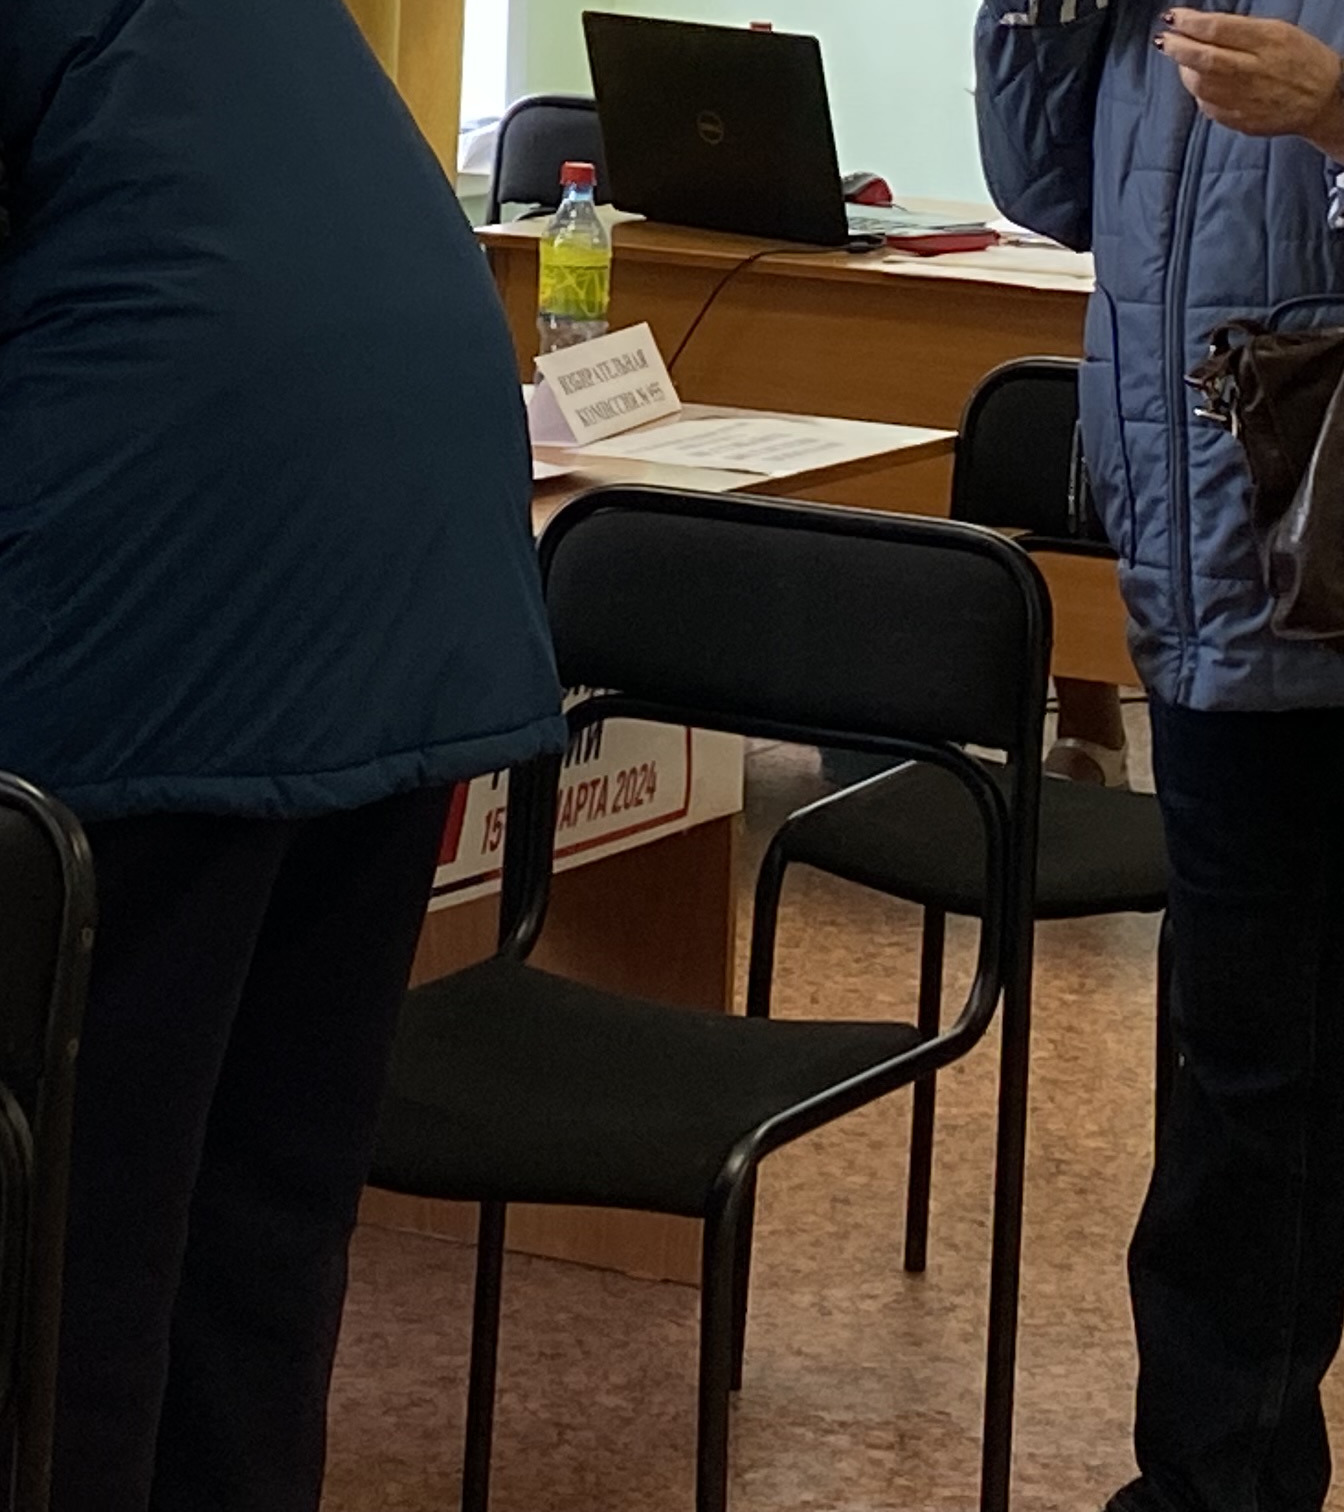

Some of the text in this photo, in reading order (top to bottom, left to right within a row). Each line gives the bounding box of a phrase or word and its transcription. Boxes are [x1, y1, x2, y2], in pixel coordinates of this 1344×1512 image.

[558, 348, 649, 396] ИЗБИРАТЕЛЬНАЯ
[558, 775, 609, 831] АРТА
[611, 760, 657, 814] 2024
